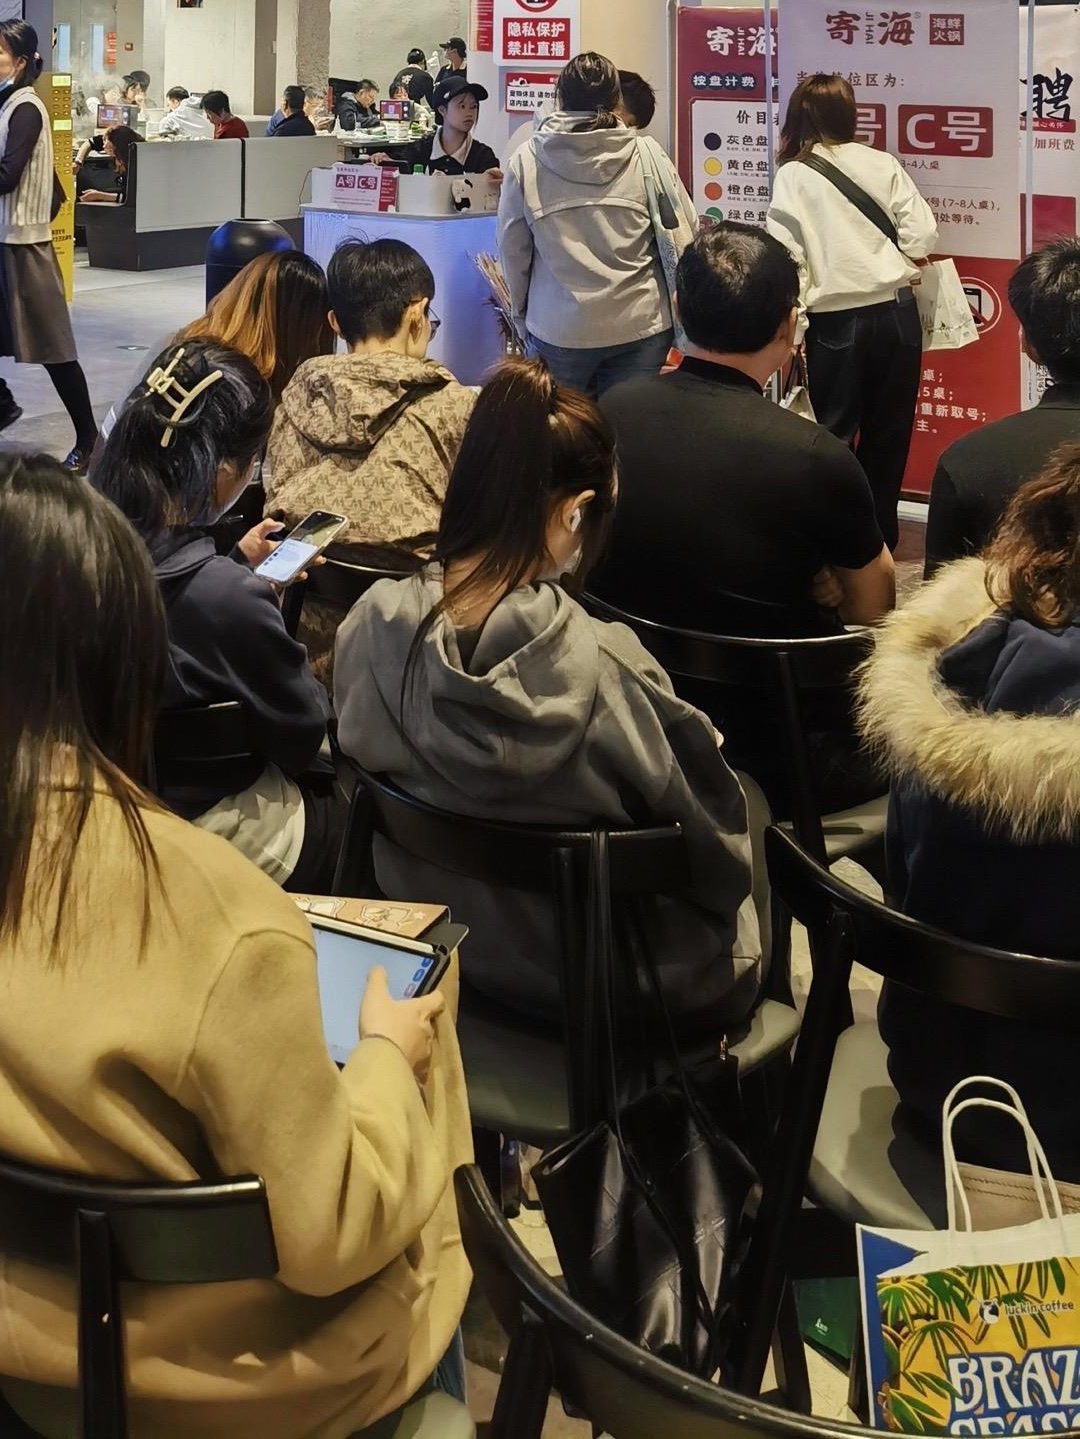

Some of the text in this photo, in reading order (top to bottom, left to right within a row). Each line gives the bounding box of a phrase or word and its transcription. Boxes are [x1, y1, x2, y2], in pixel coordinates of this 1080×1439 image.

[507, 22, 566, 38] 隐私保护
[826, 10, 915, 46] 寄海
[932, 17, 962, 30] 海鲜
[932, 30, 962, 42] 火锅
[507, 41, 566, 56] 禁止直播
[693, 73, 755, 88] 按盘计费
[906, 111, 987, 152] C号
[726, 134, 769, 146] 灰色盘
[1033, 137, 1075, 151] 加班费
[726, 159, 769, 171] 黄色盘
[727, 184, 770, 197] 橙色盘
[1005, 1299, 1074, 1315] luckin coffee
